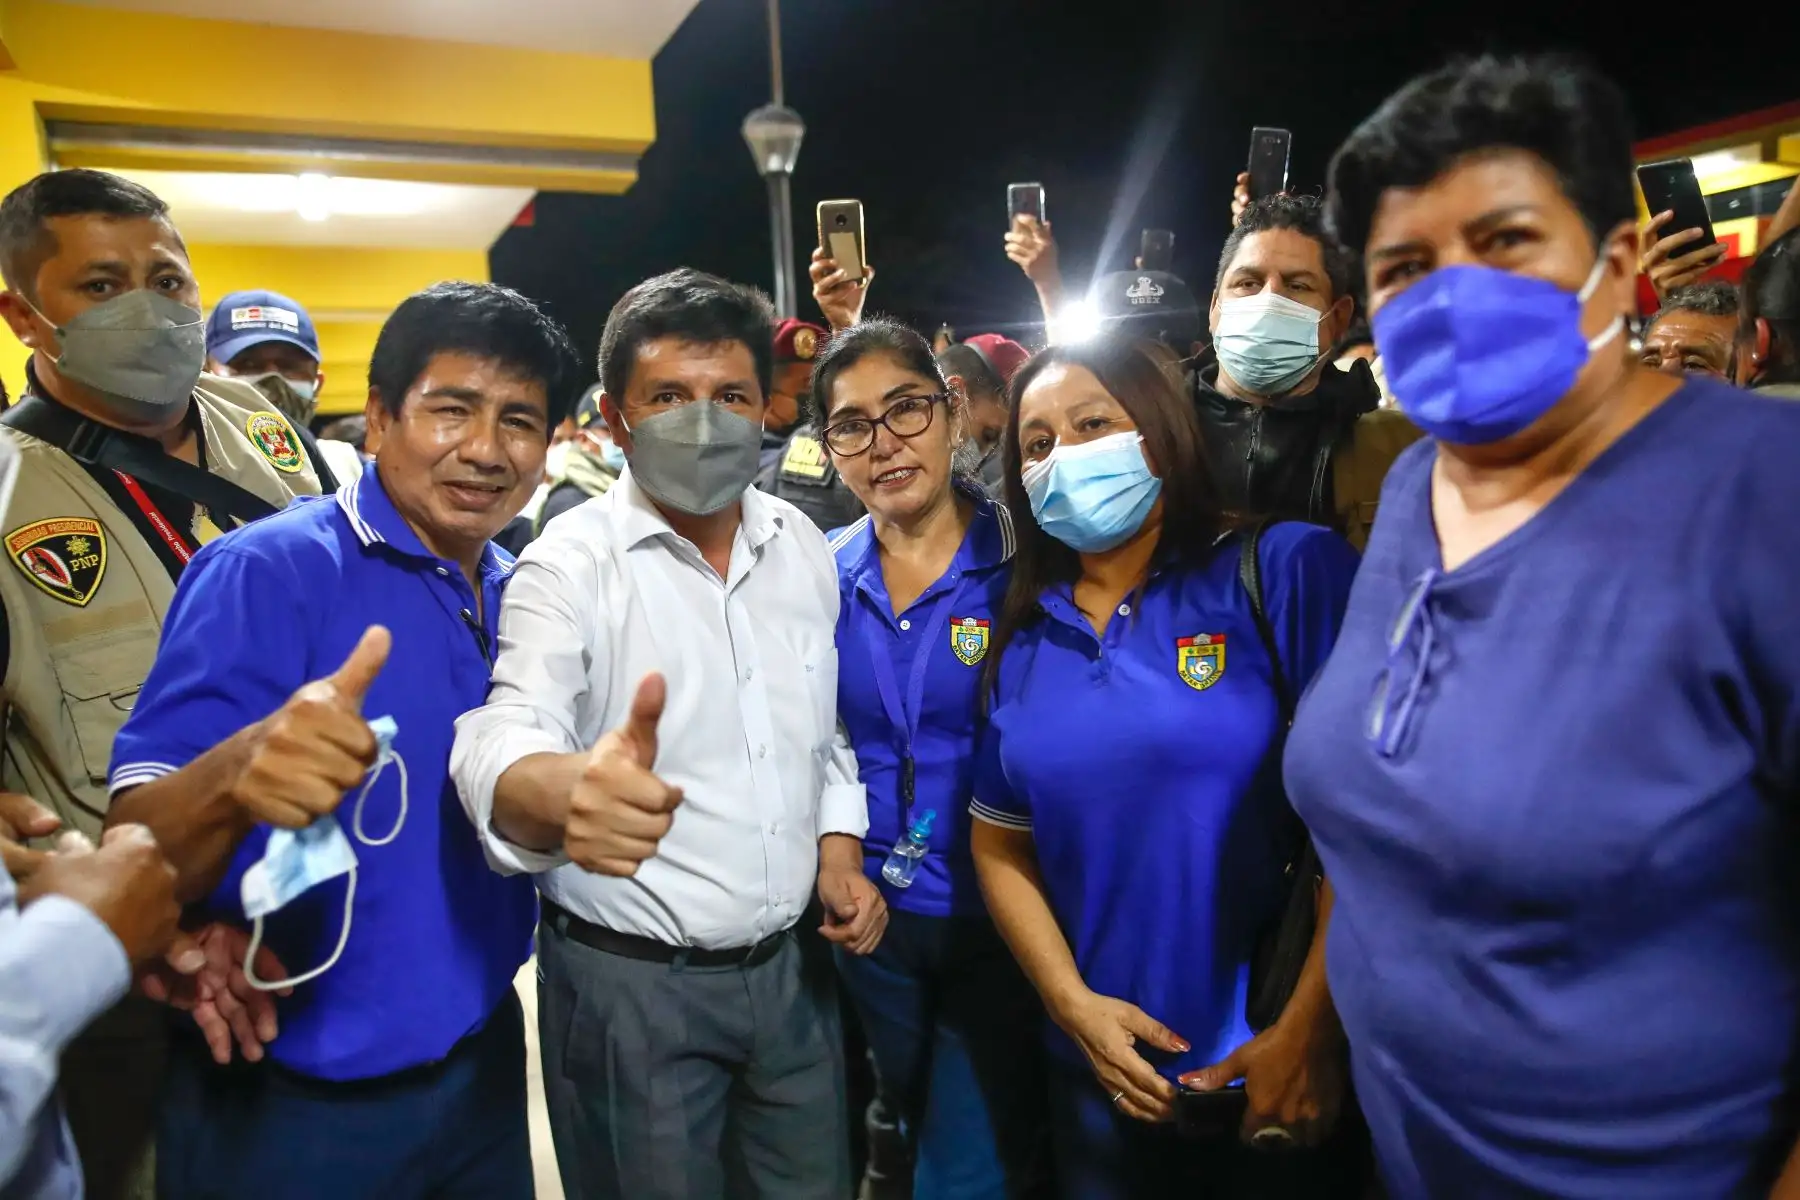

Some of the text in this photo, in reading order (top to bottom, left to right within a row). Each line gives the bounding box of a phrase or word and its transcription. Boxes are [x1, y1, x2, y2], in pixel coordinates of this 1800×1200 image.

[48, 520, 96, 533] PRESIDENCIAL
[149, 511, 175, 541] Presidencial
[69, 554, 99, 572] PNP
